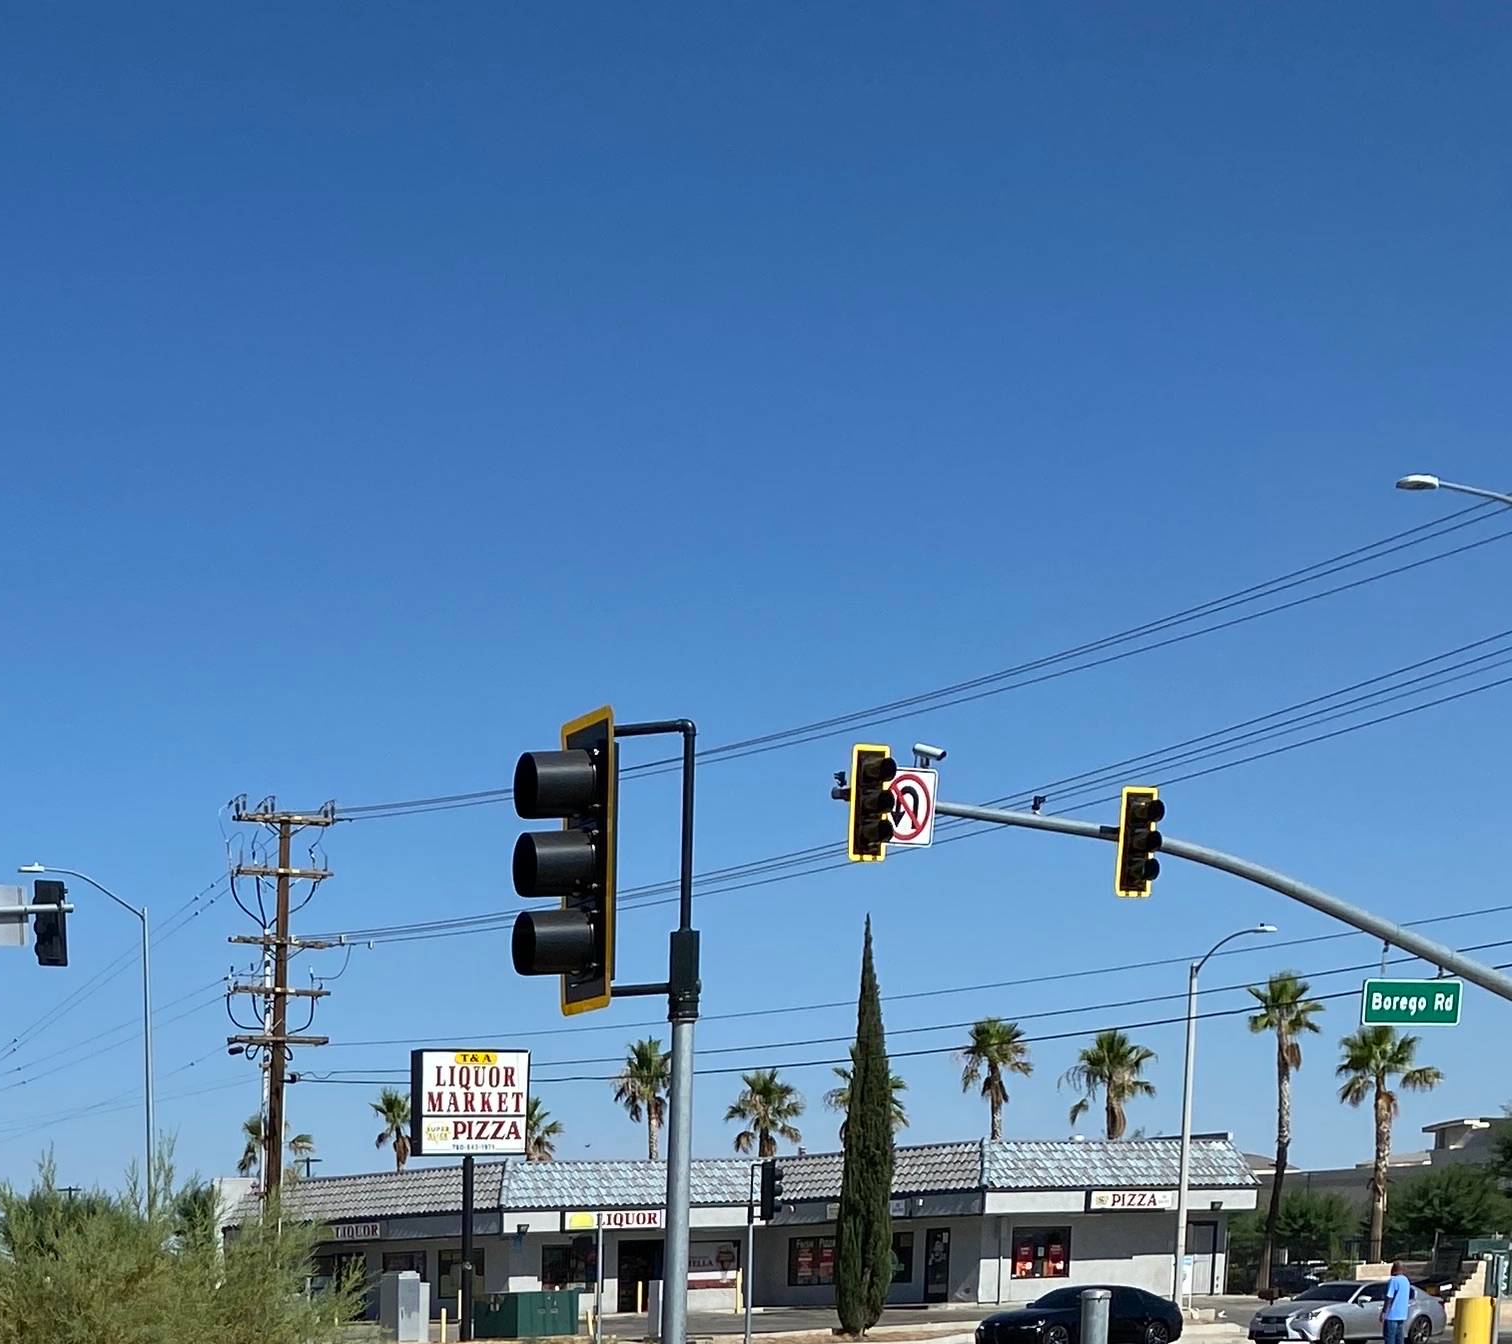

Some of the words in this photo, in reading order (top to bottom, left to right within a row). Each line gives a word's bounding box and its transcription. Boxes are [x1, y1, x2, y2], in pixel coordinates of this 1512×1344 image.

[1371, 992, 1426, 1016] Borego
[1433, 993, 1453, 1011] Rd
[435, 1065, 516, 1091] LIQUOR
[427, 1091, 524, 1113] MARKET
[452, 1120, 522, 1140] PIZZA
[1111, 1193, 1157, 1207] PIZZA
[336, 1224, 378, 1239] LIQUOR
